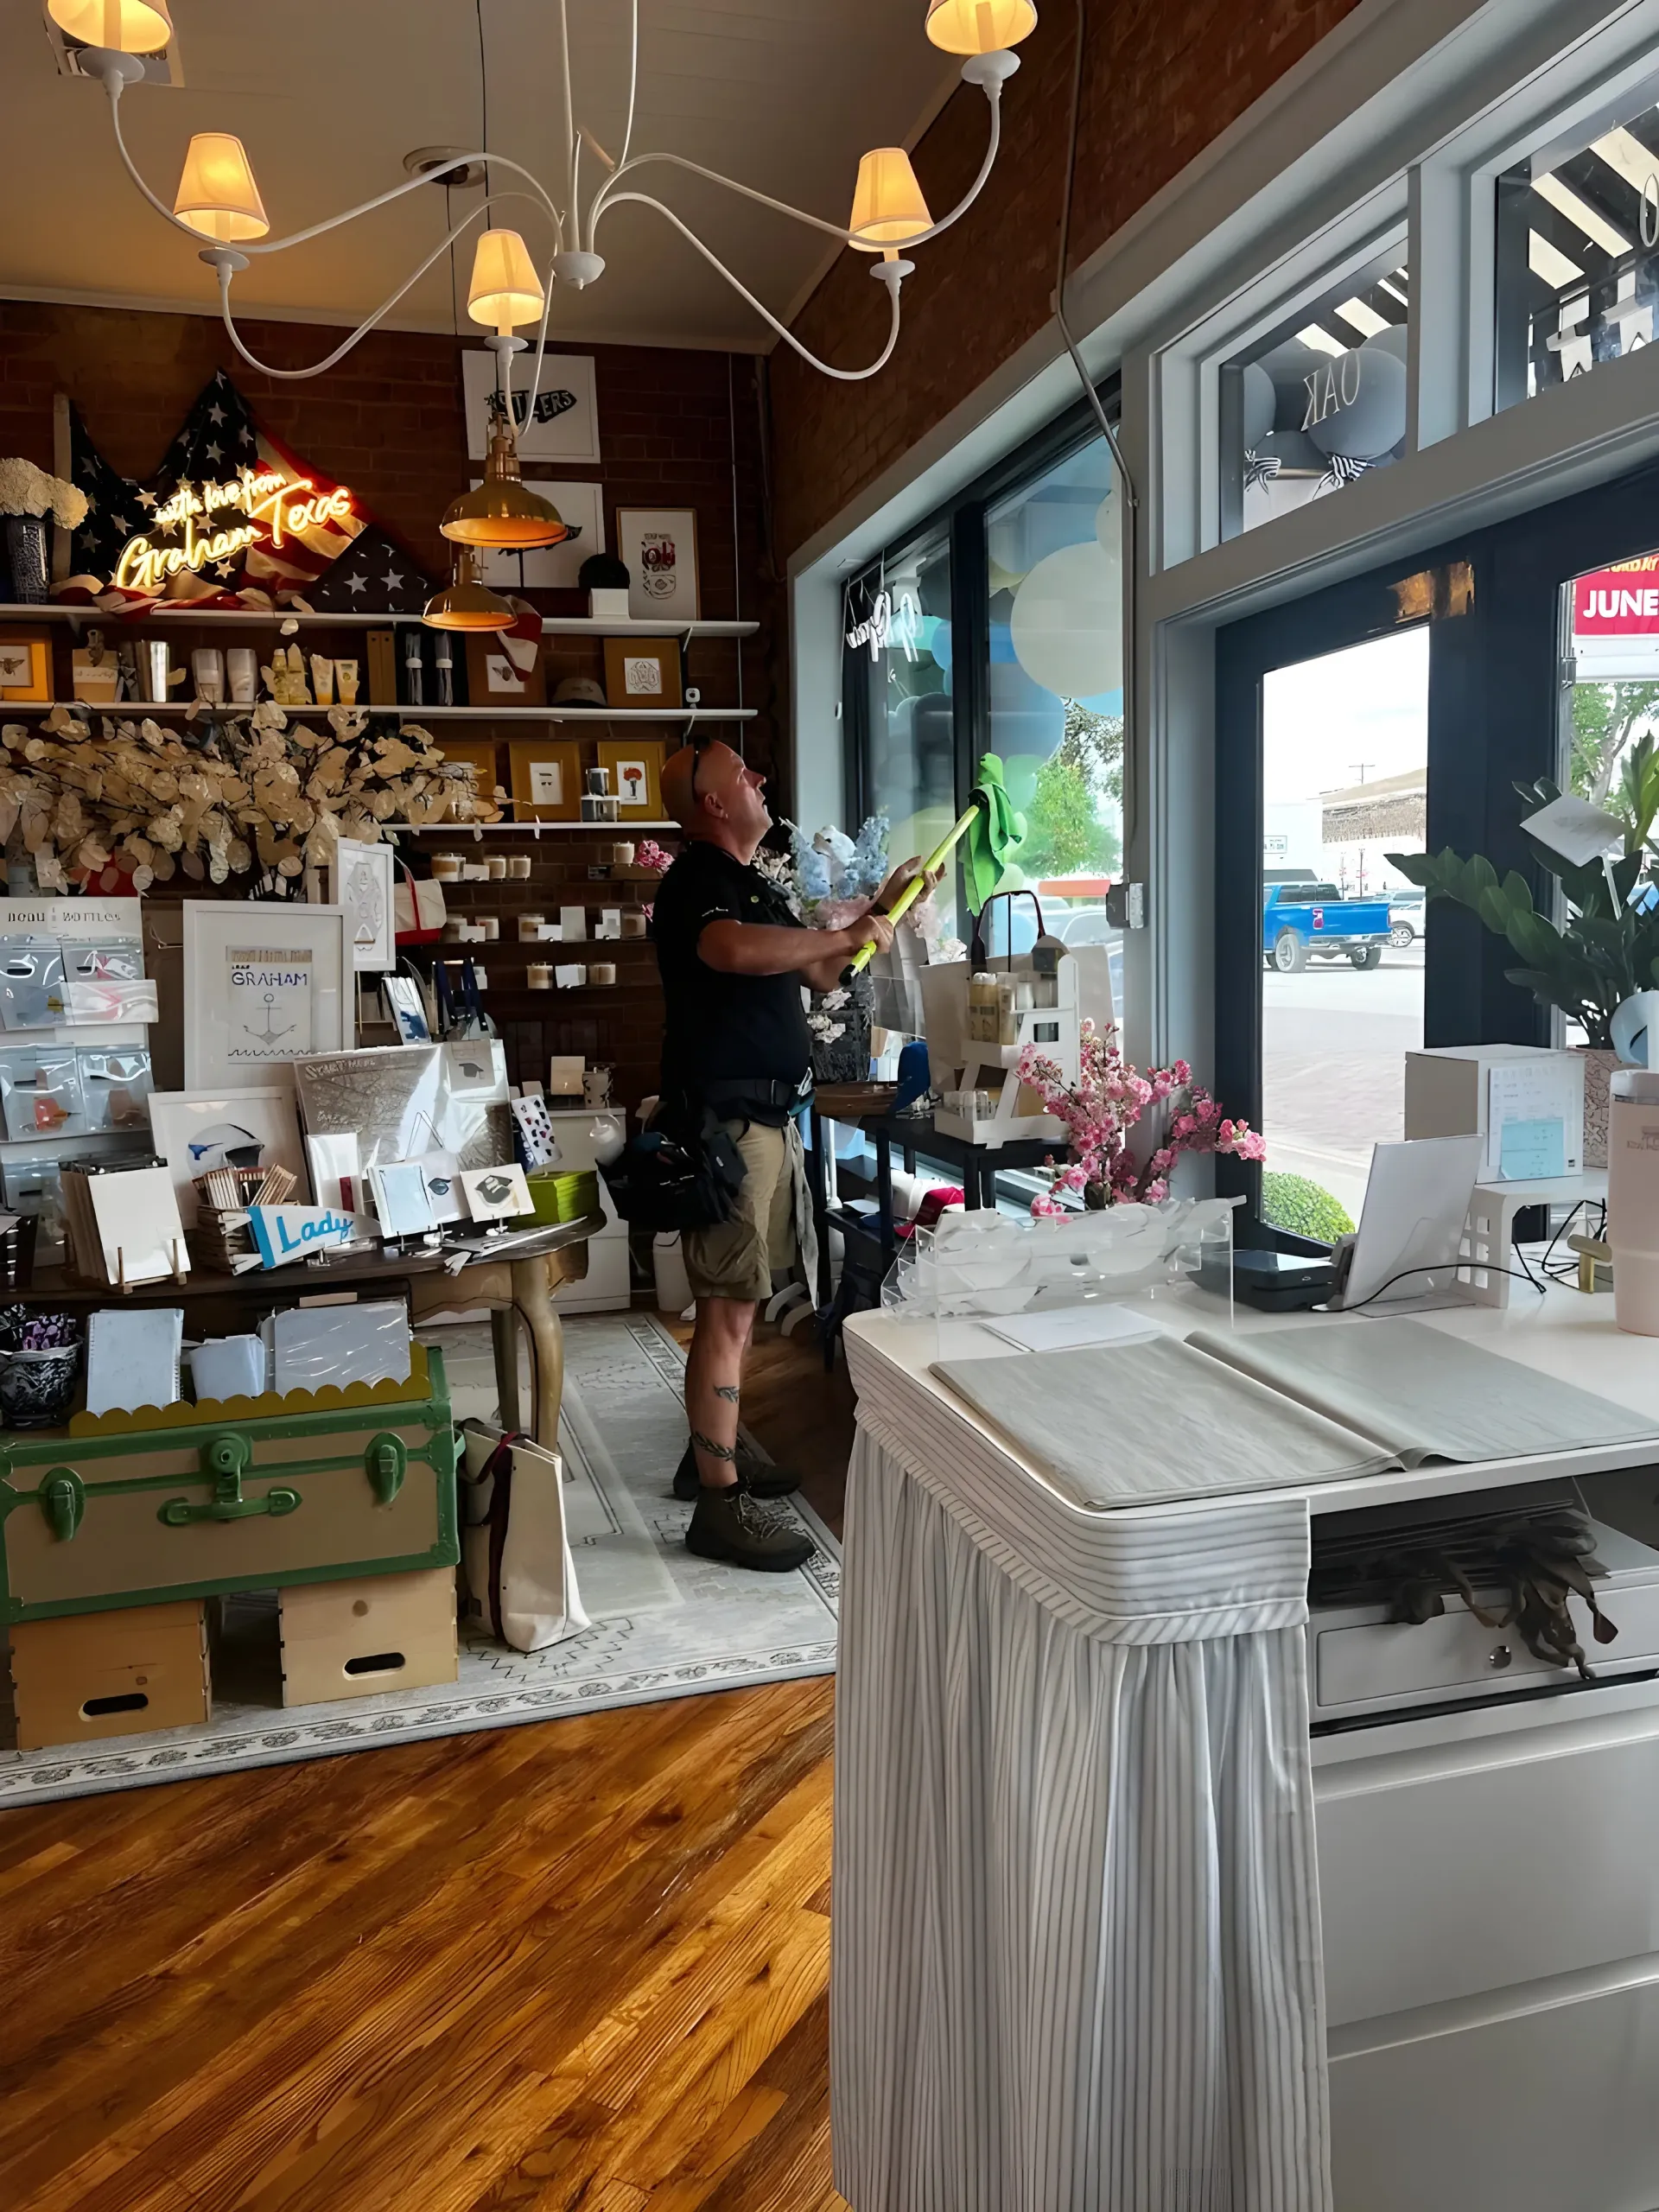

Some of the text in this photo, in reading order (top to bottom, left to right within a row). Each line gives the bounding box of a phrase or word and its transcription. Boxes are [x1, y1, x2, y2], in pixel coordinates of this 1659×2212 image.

[152, 468, 288, 523] with love from
[117, 479, 352, 588] Graham Texas
[1583, 589, 1659, 618] JUNE
[232, 972, 308, 987] GRAHAM
[276, 1210, 354, 1254] Lady
